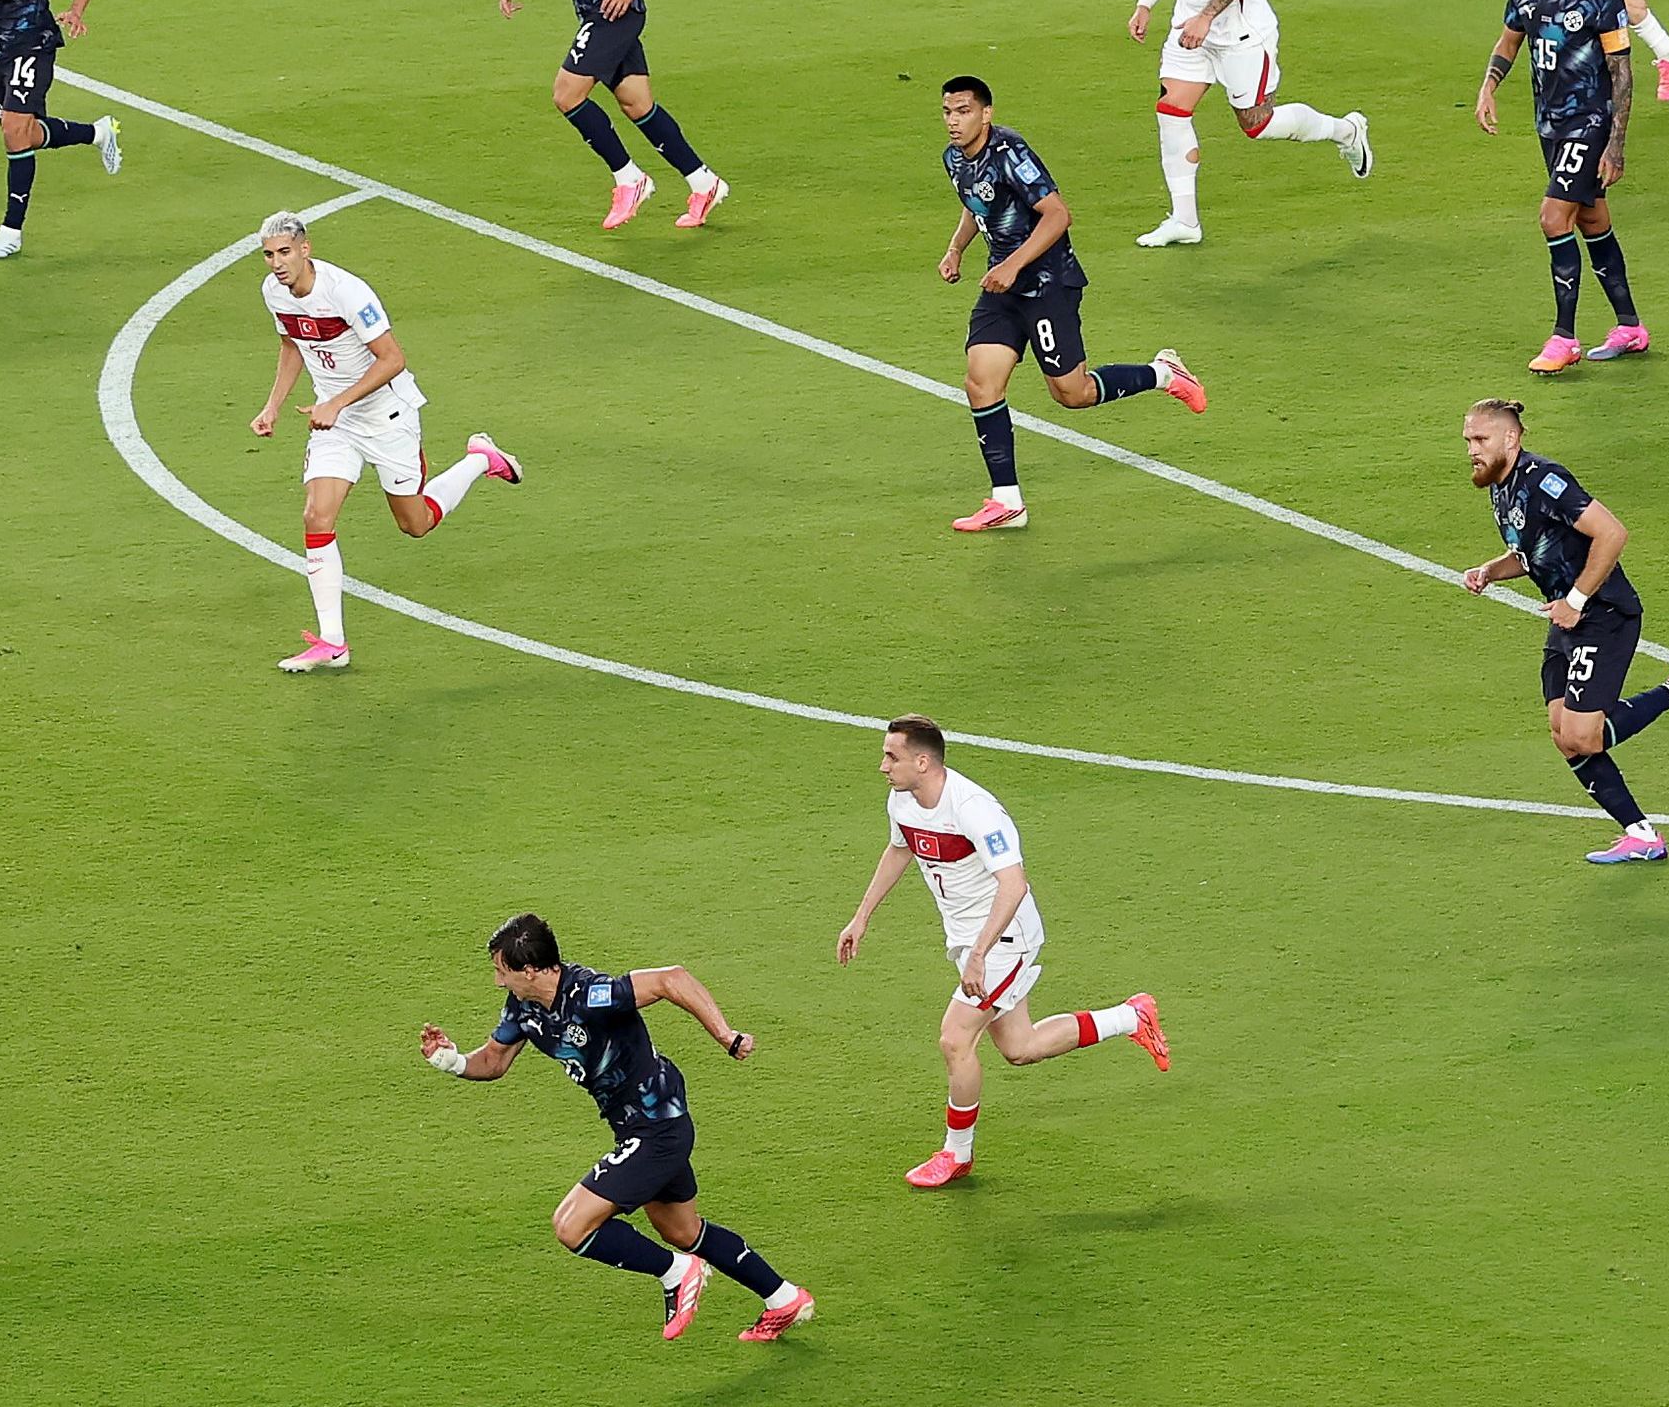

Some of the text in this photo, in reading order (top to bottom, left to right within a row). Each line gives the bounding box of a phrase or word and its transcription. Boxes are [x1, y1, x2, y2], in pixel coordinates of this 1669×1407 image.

[576, 21, 595, 50] 4
[1536, 38, 1558, 71] 15
[9, 56, 37, 88] 14
[1555, 141, 1589, 174] 15
[1036, 317, 1056, 353] 8
[316, 349, 336, 370] 18
[1567, 645, 1598, 682] 25
[932, 872, 948, 900] 7
